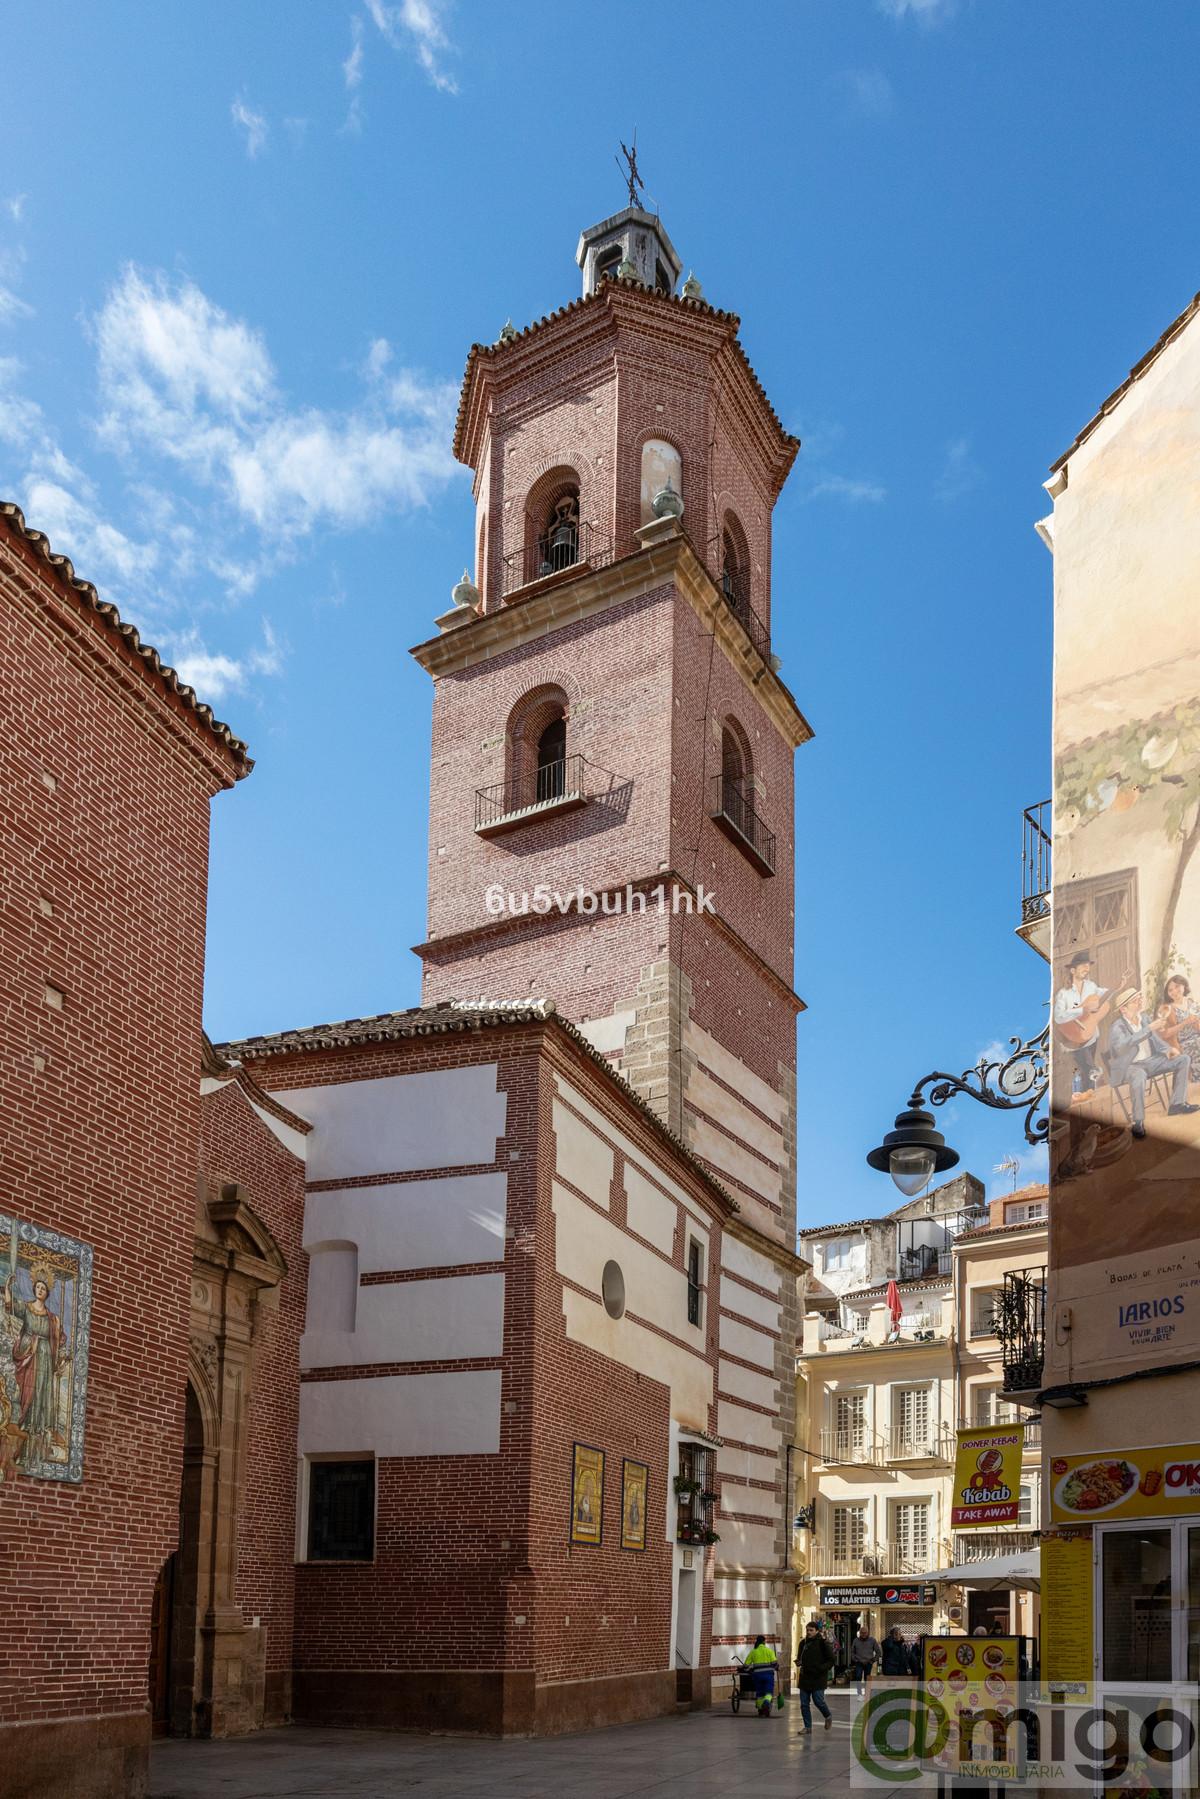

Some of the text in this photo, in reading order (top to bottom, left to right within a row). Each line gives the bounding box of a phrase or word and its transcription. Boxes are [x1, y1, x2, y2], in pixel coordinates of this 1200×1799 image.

[1119, 1295, 1184, 1328] LARIOS
[962, 1486, 1011, 1504] Kebab
[958, 1506, 1013, 1519] TAKE AWAY
[827, 1588, 878, 1596] MINIMARKET
